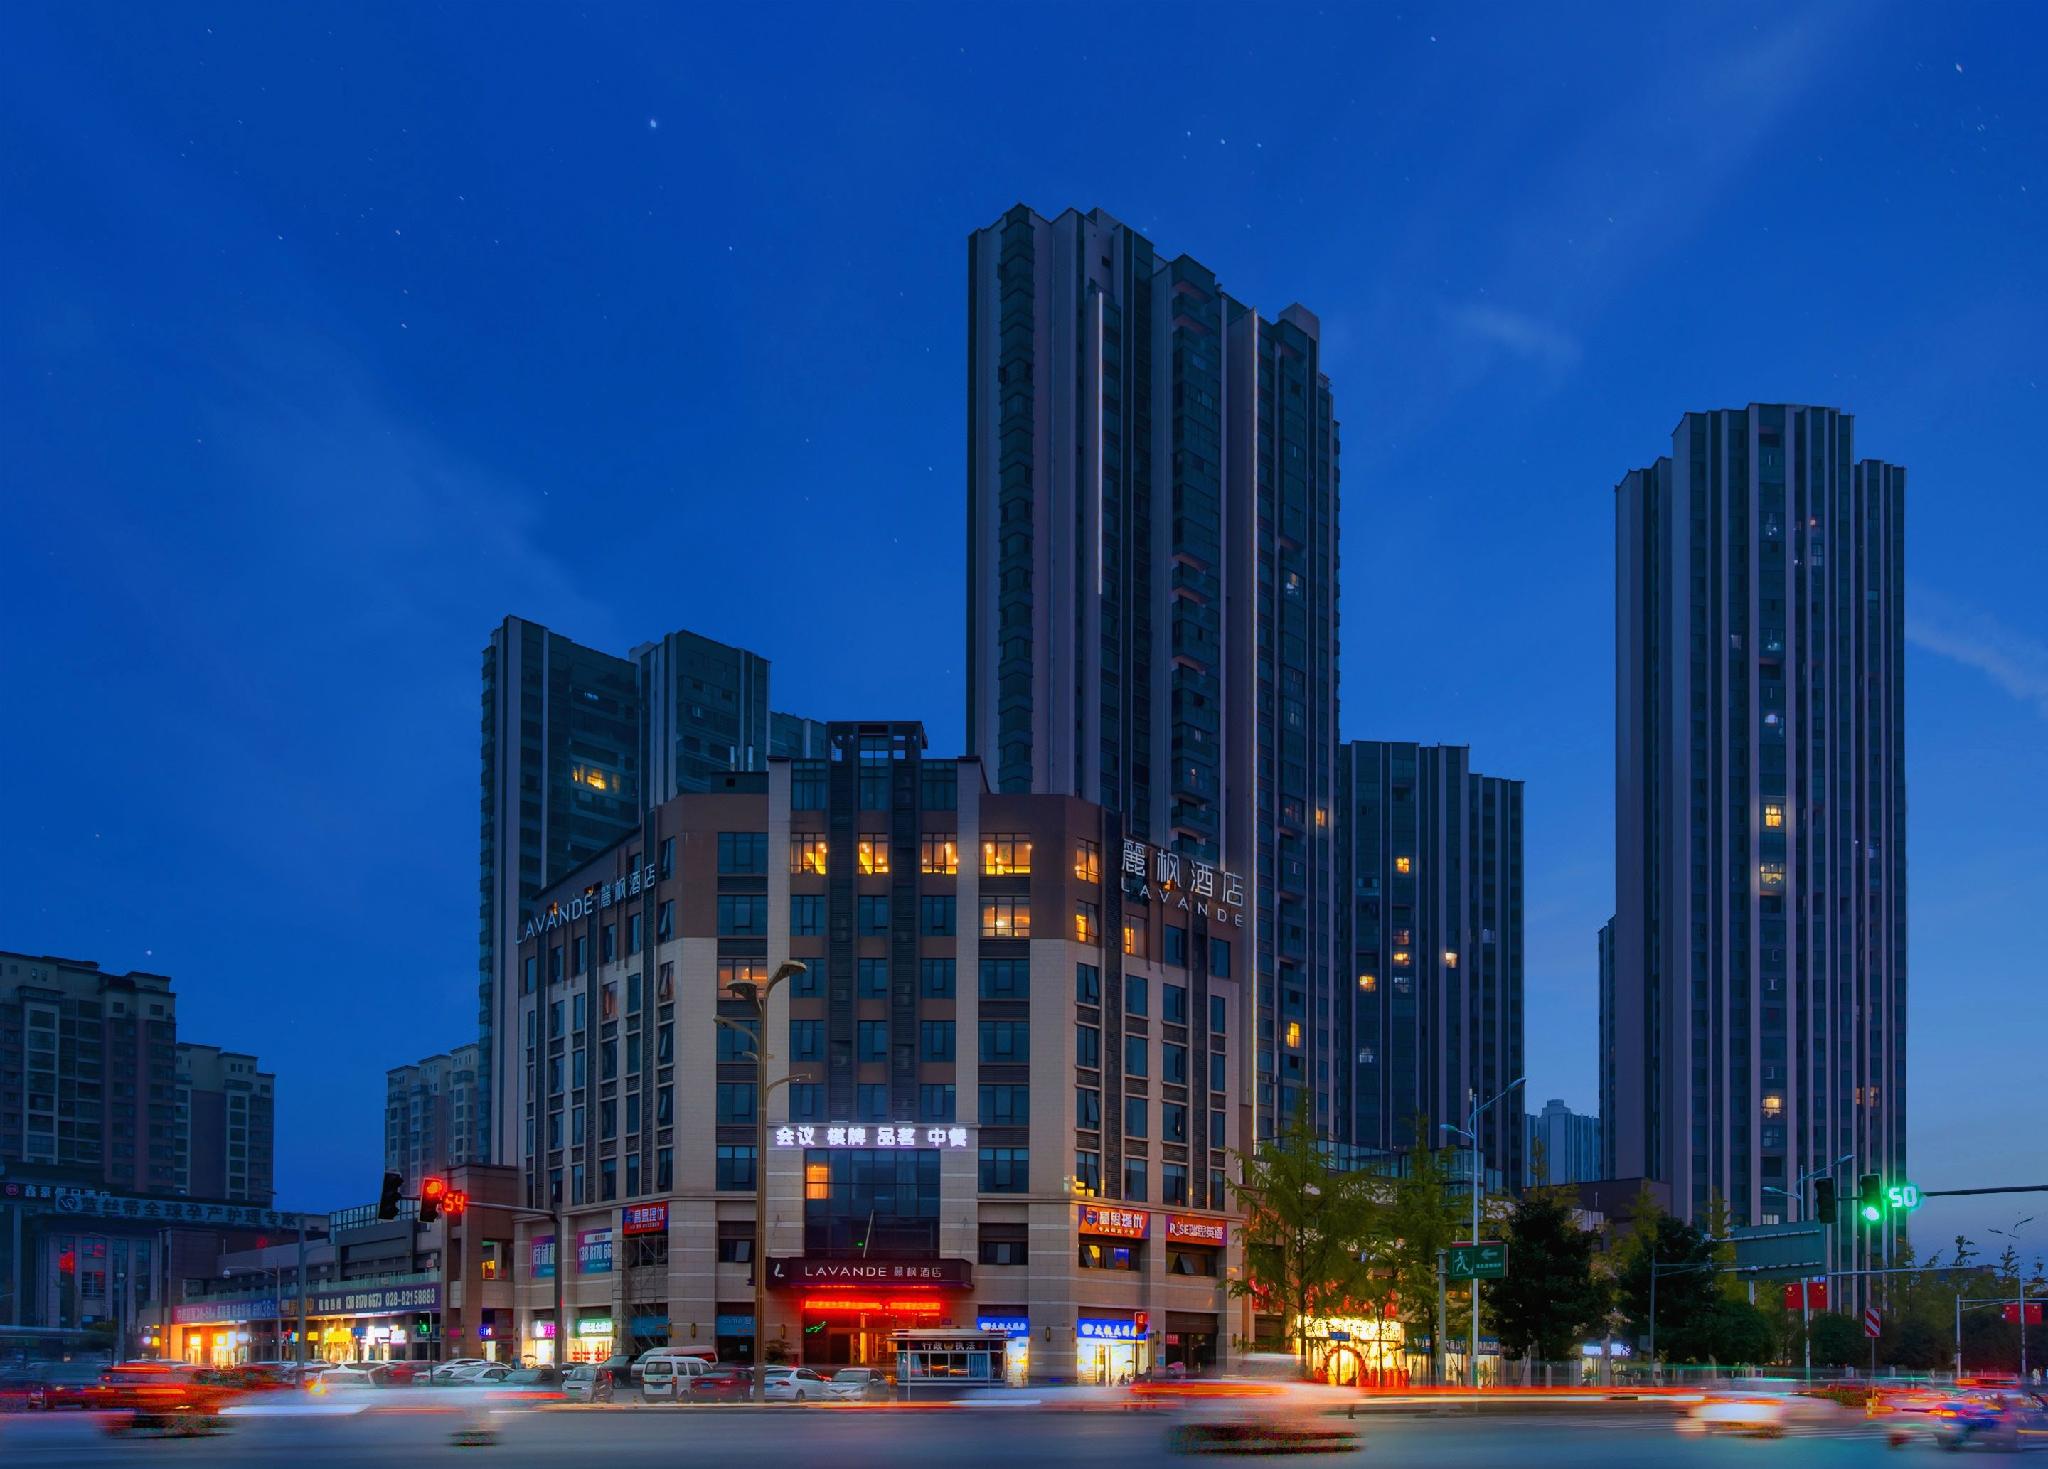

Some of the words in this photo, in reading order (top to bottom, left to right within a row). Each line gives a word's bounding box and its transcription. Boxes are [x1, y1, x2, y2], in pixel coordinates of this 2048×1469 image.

[1121, 877, 1244, 927] LAVANDE
[515, 893, 593, 945] LAVANDE
[776, 1126, 815, 1146] 会议
[827, 1127, 866, 1146] 棋牌
[877, 1126, 915, 1146] 品茗
[928, 1127, 967, 1147] 中餐
[443, 1193, 465, 1212] 54
[1888, 1186, 1918, 1208] 50
[805, 1266, 888, 1277] LAVANDE
